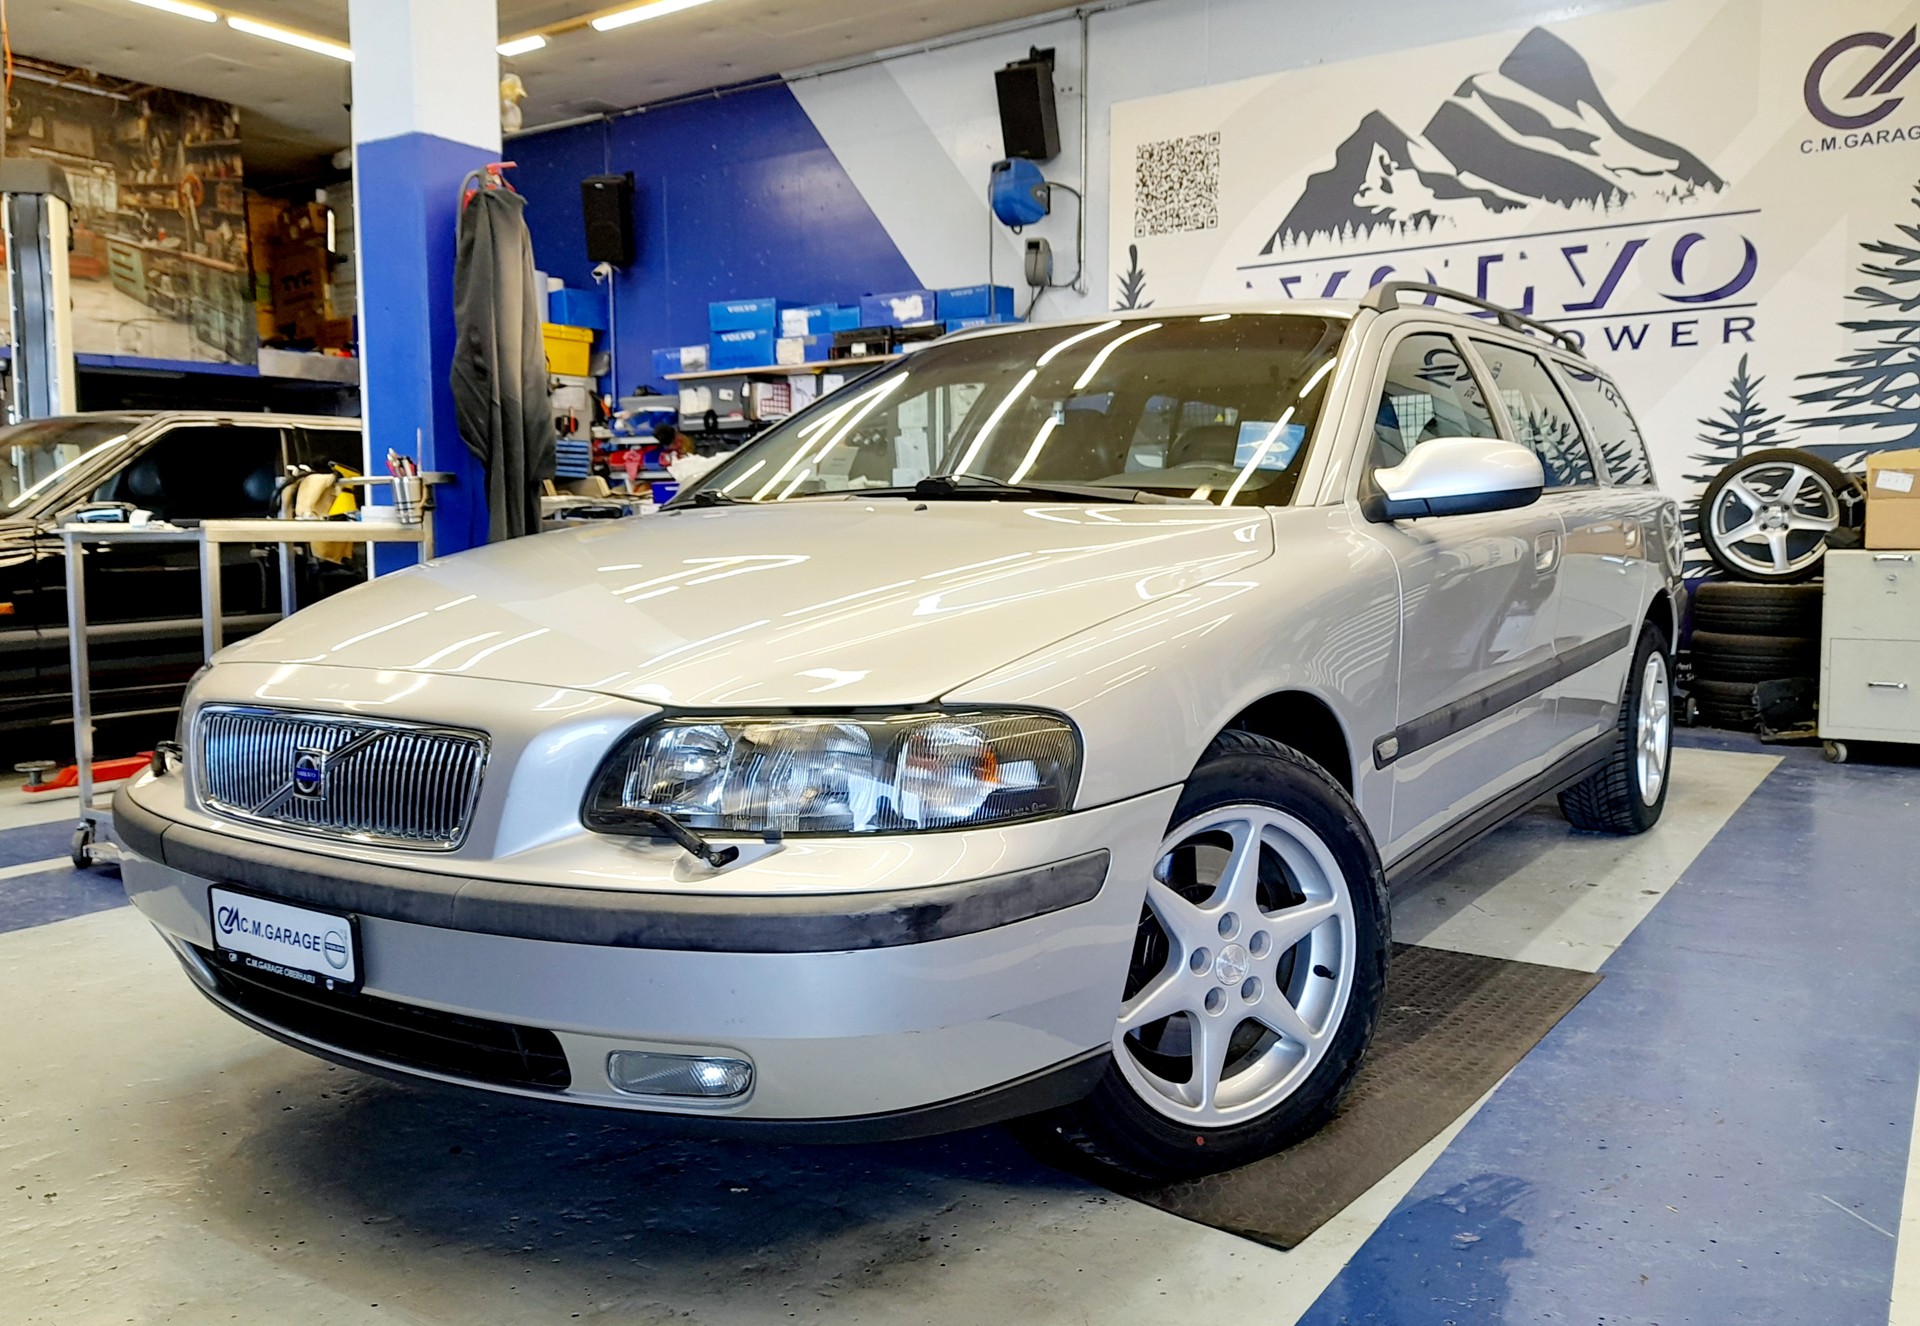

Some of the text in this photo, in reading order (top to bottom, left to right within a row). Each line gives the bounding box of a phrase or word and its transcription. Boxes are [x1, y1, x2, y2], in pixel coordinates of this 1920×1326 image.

[726, 303, 758, 314] VOLVO
[720, 331, 756, 343] VOLVO
[1523, 316, 1756, 351] OWER
[296, 770, 317, 778] VOLVO
[240, 915, 321, 952] C.M.GARAGE
